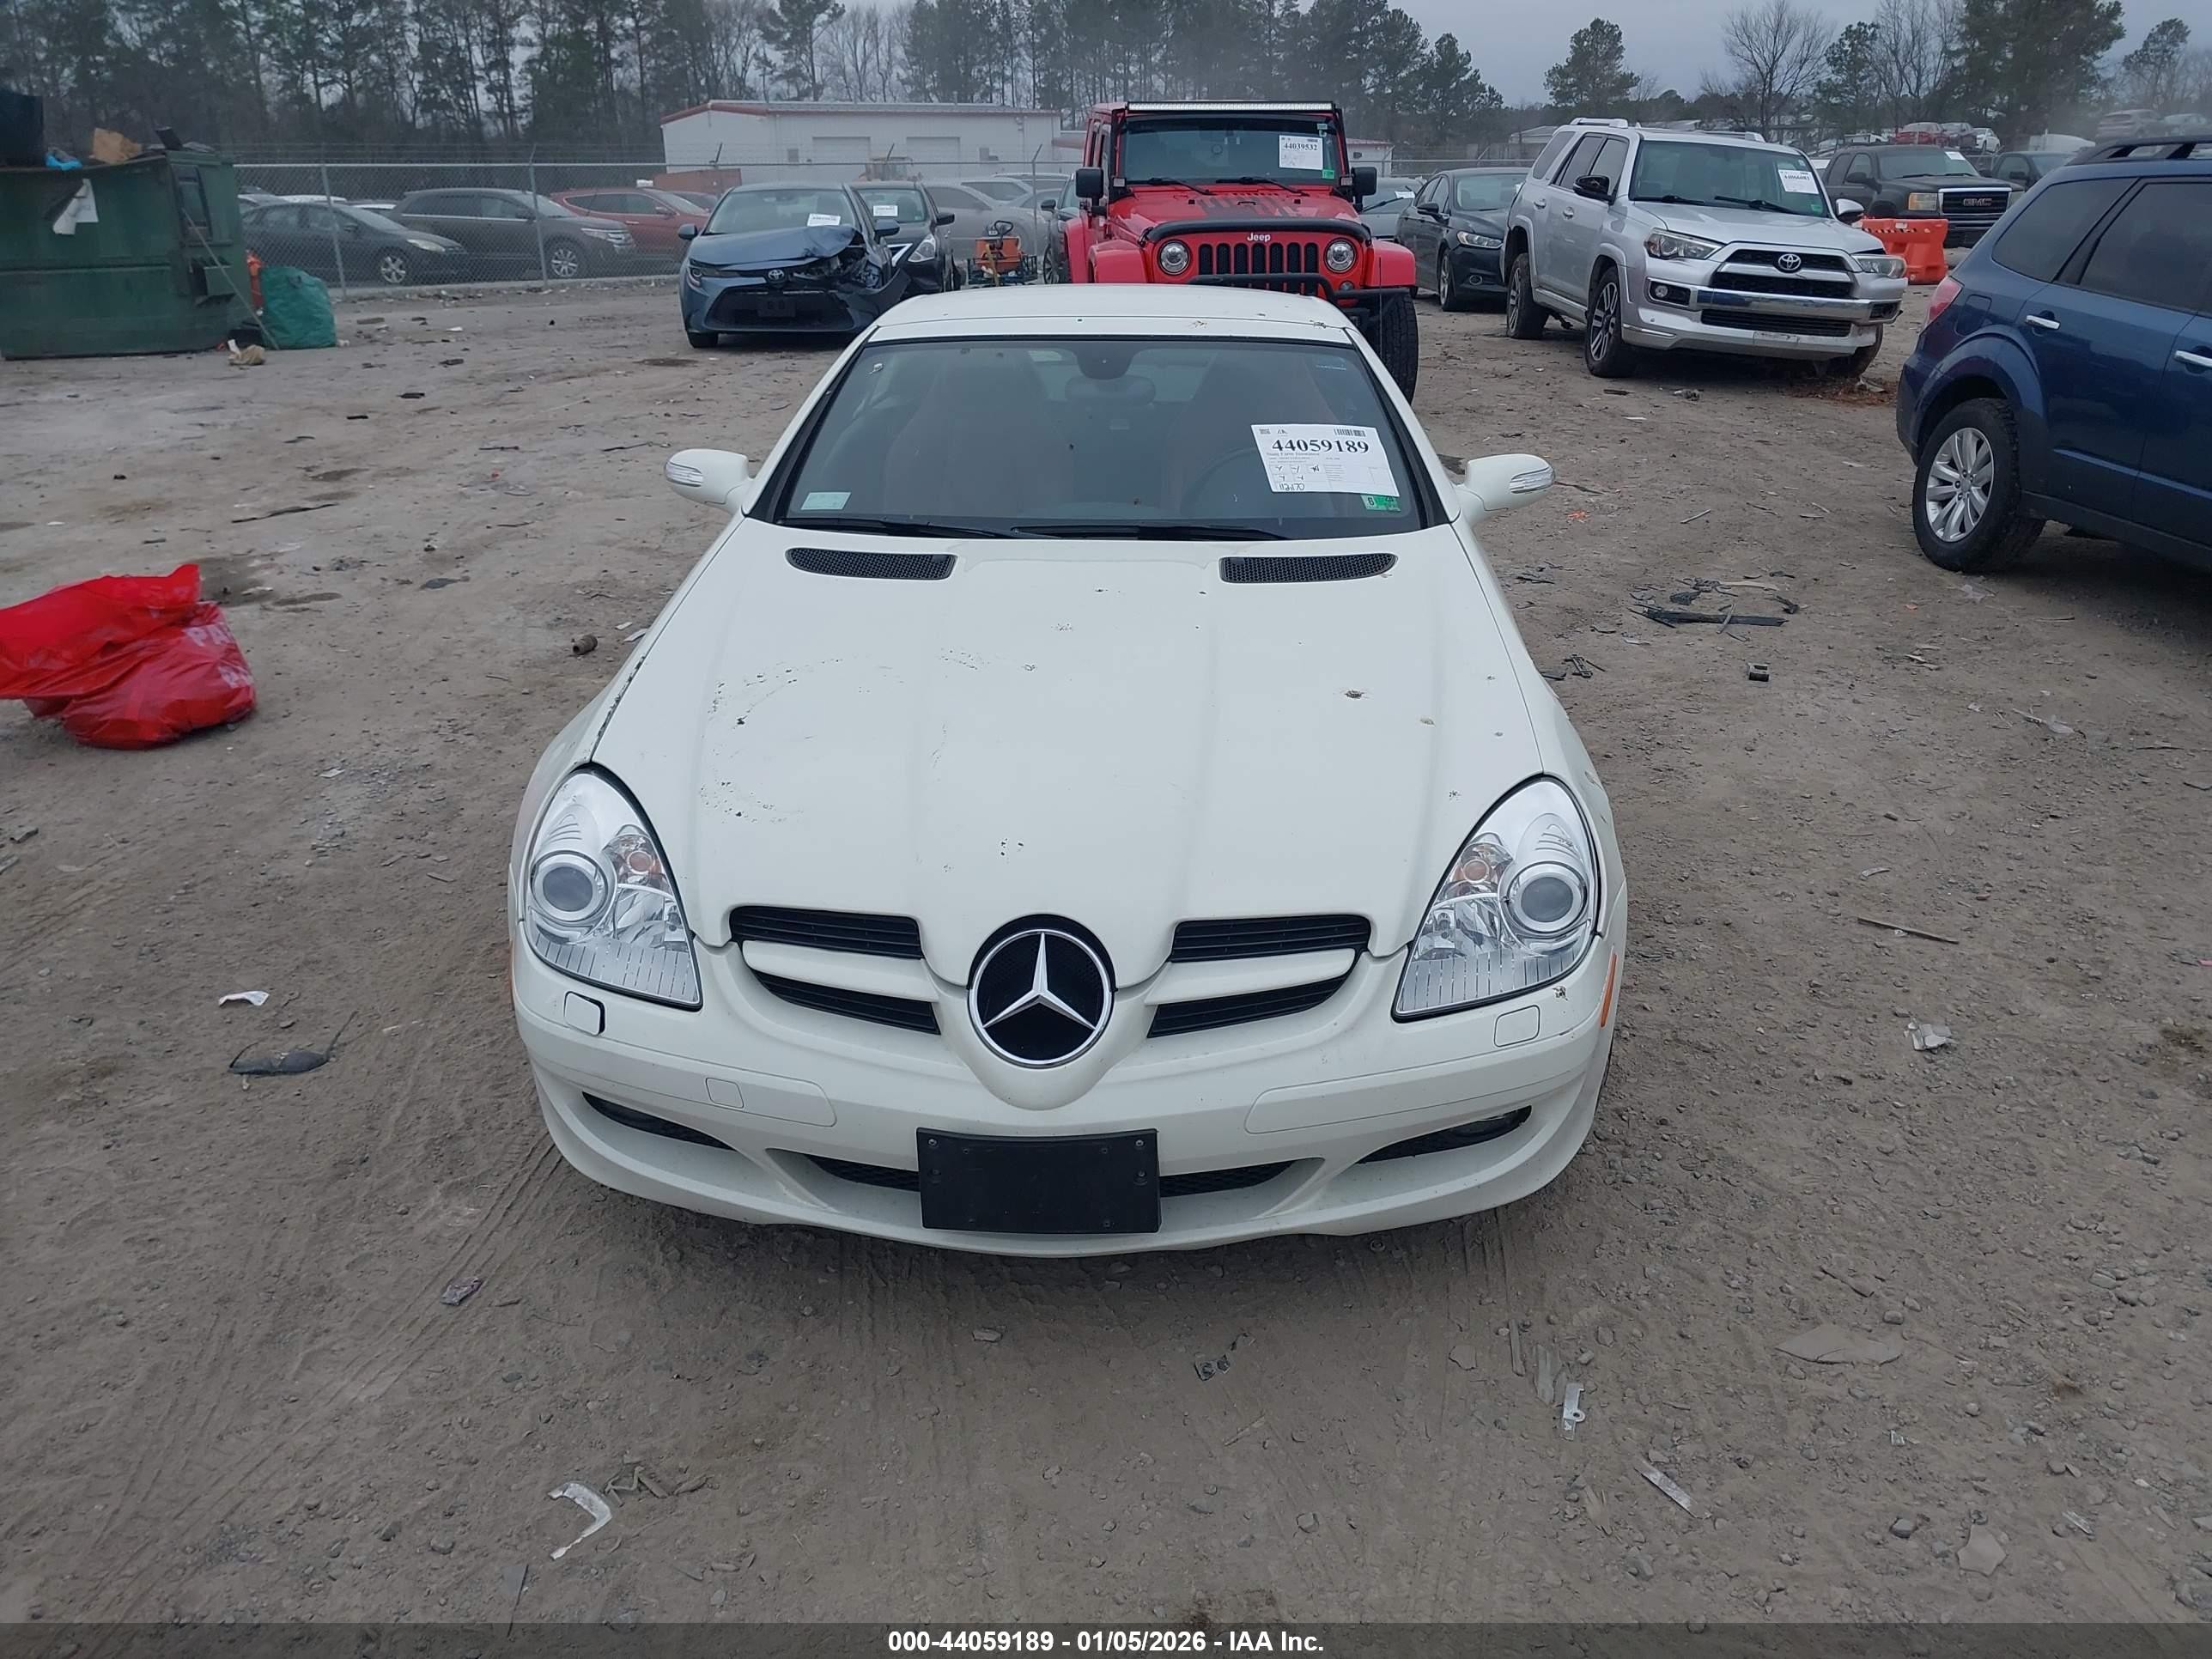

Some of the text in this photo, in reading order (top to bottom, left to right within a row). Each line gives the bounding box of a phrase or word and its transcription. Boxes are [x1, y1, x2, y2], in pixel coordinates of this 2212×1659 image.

[1283, 143, 1318, 151] 44039532
[1963, 198, 1993, 207] GMC
[1247, 233, 1271, 242] Jeep
[1272, 439, 1369, 453] 44059189
